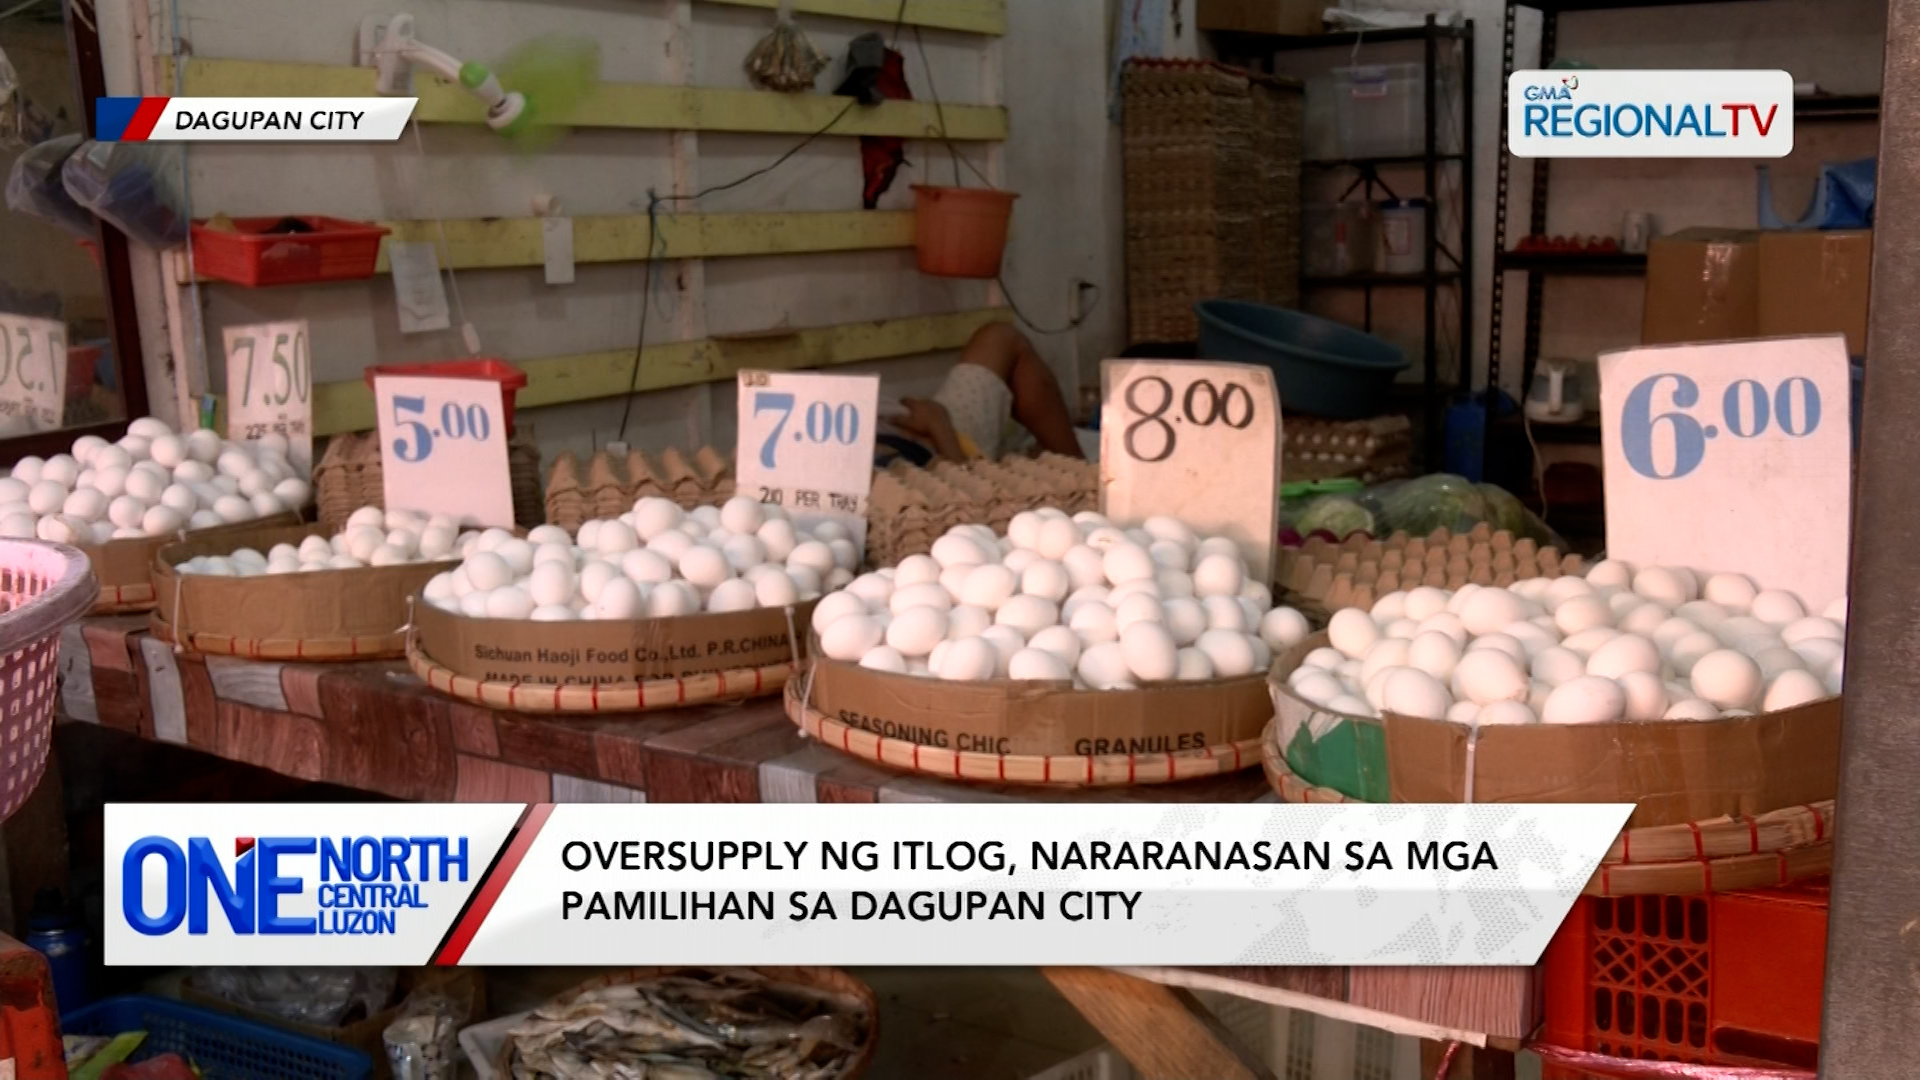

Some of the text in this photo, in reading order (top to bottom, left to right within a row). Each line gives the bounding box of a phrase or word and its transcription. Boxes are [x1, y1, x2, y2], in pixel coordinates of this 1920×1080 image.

[232, 331, 310, 407] 7.50
[393, 395, 490, 463] 5.00
[754, 392, 859, 469] 7.00
[1124, 375, 1254, 462] 8.00
[1621, 373, 1821, 480] 6.00
[795, 490, 819, 508] PER
[474, 644, 532, 662] Sichuan
[537, 648, 580, 667] Haoji
[586, 649, 629, 663] Food
[838, 709, 949, 749] SEASONING
[1074, 731, 1205, 756] GRANULES
